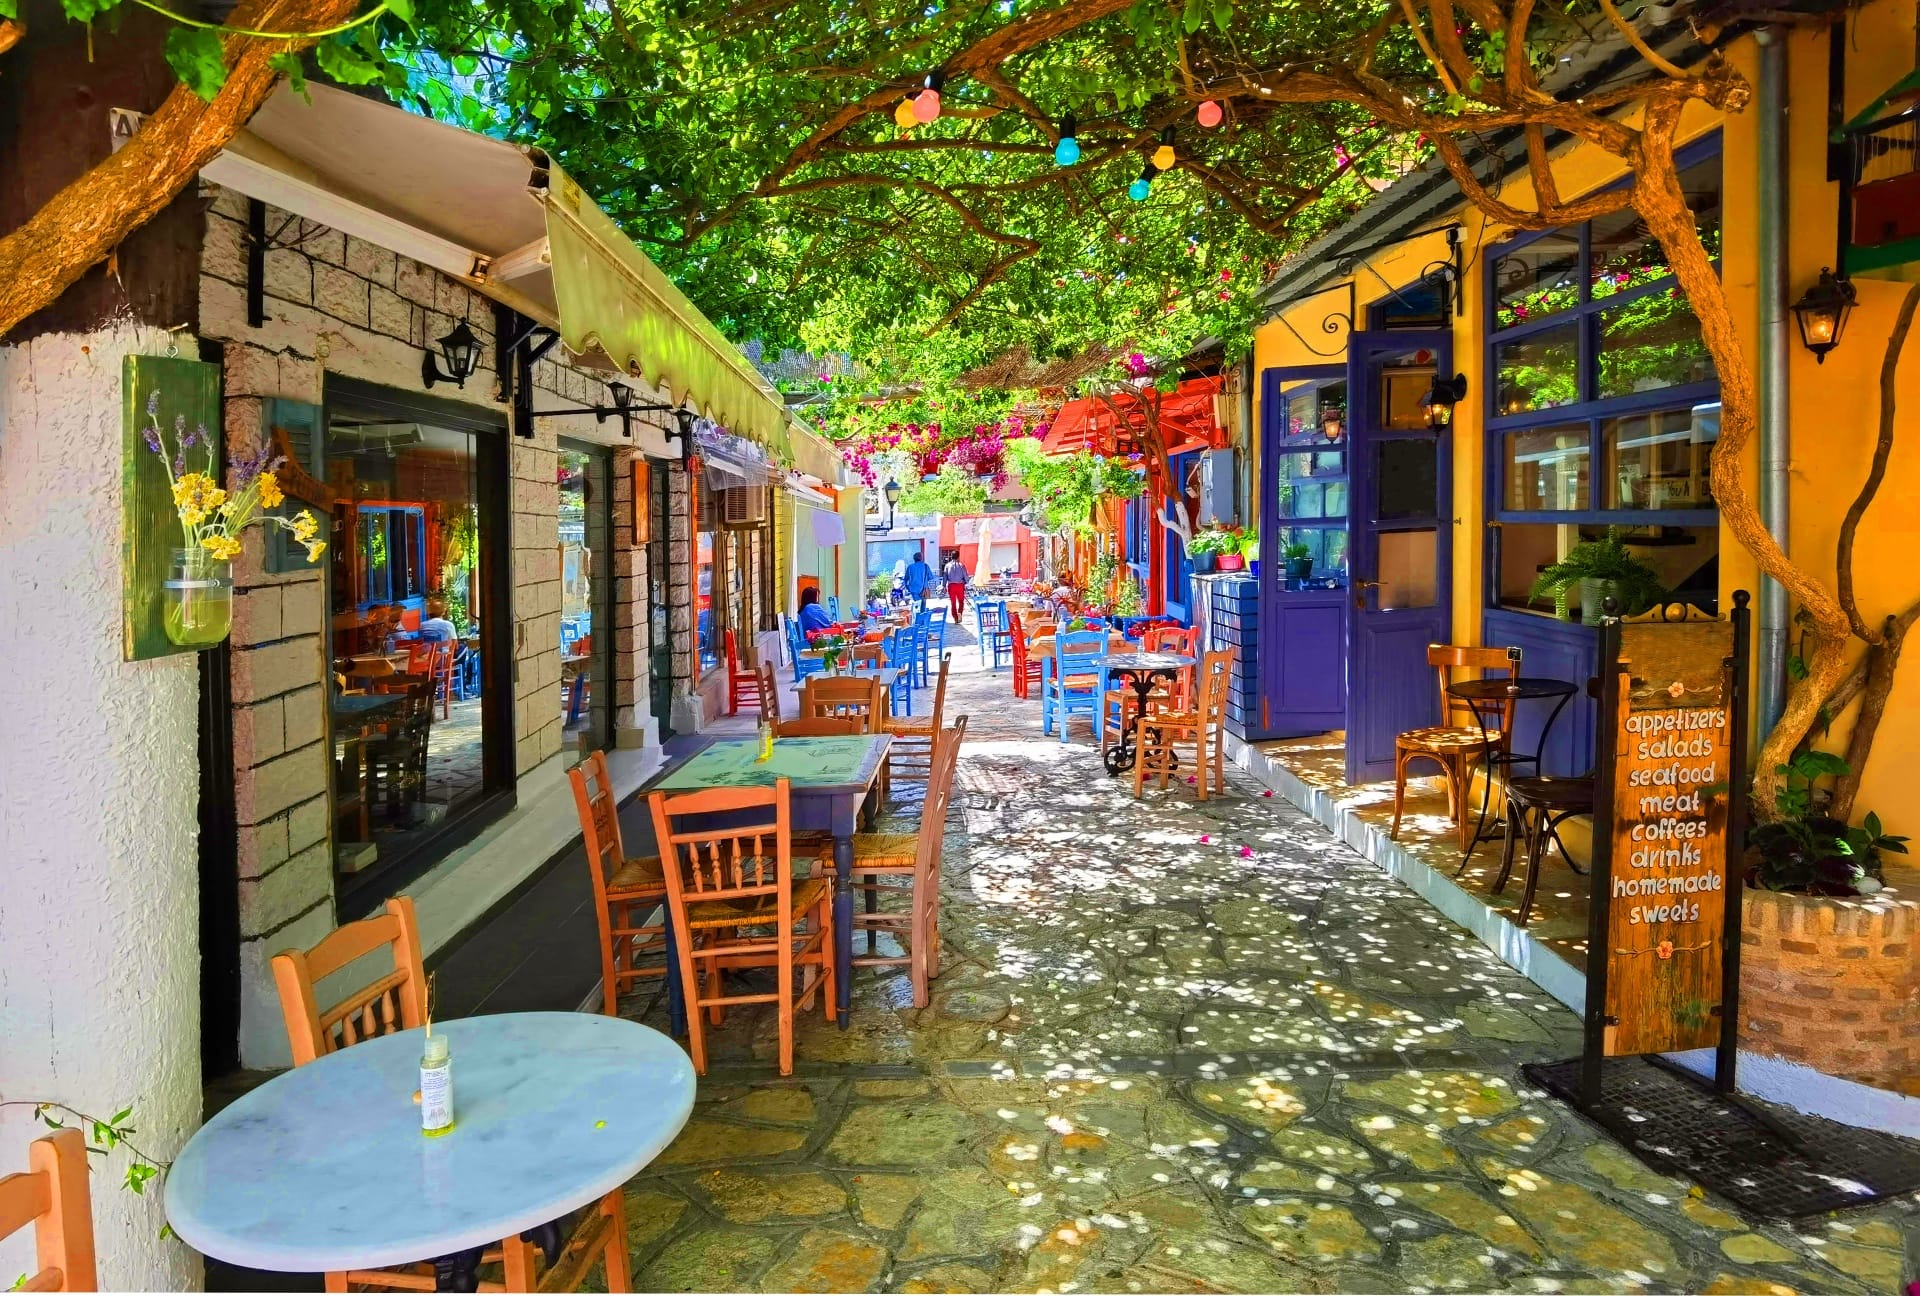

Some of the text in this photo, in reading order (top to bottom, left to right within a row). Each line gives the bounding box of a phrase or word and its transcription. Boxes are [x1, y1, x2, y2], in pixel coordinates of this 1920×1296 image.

[1625, 708, 1726, 738] appetizers
[1637, 733, 1713, 760] salads
[1629, 761, 1716, 787] seafood
[1639, 790, 1700, 813] meat
[1631, 817, 1708, 841] coffees
[1630, 842, 1702, 868] drinks
[1612, 869, 1722, 898] homemade
[1629, 898, 1700, 924] sweets
